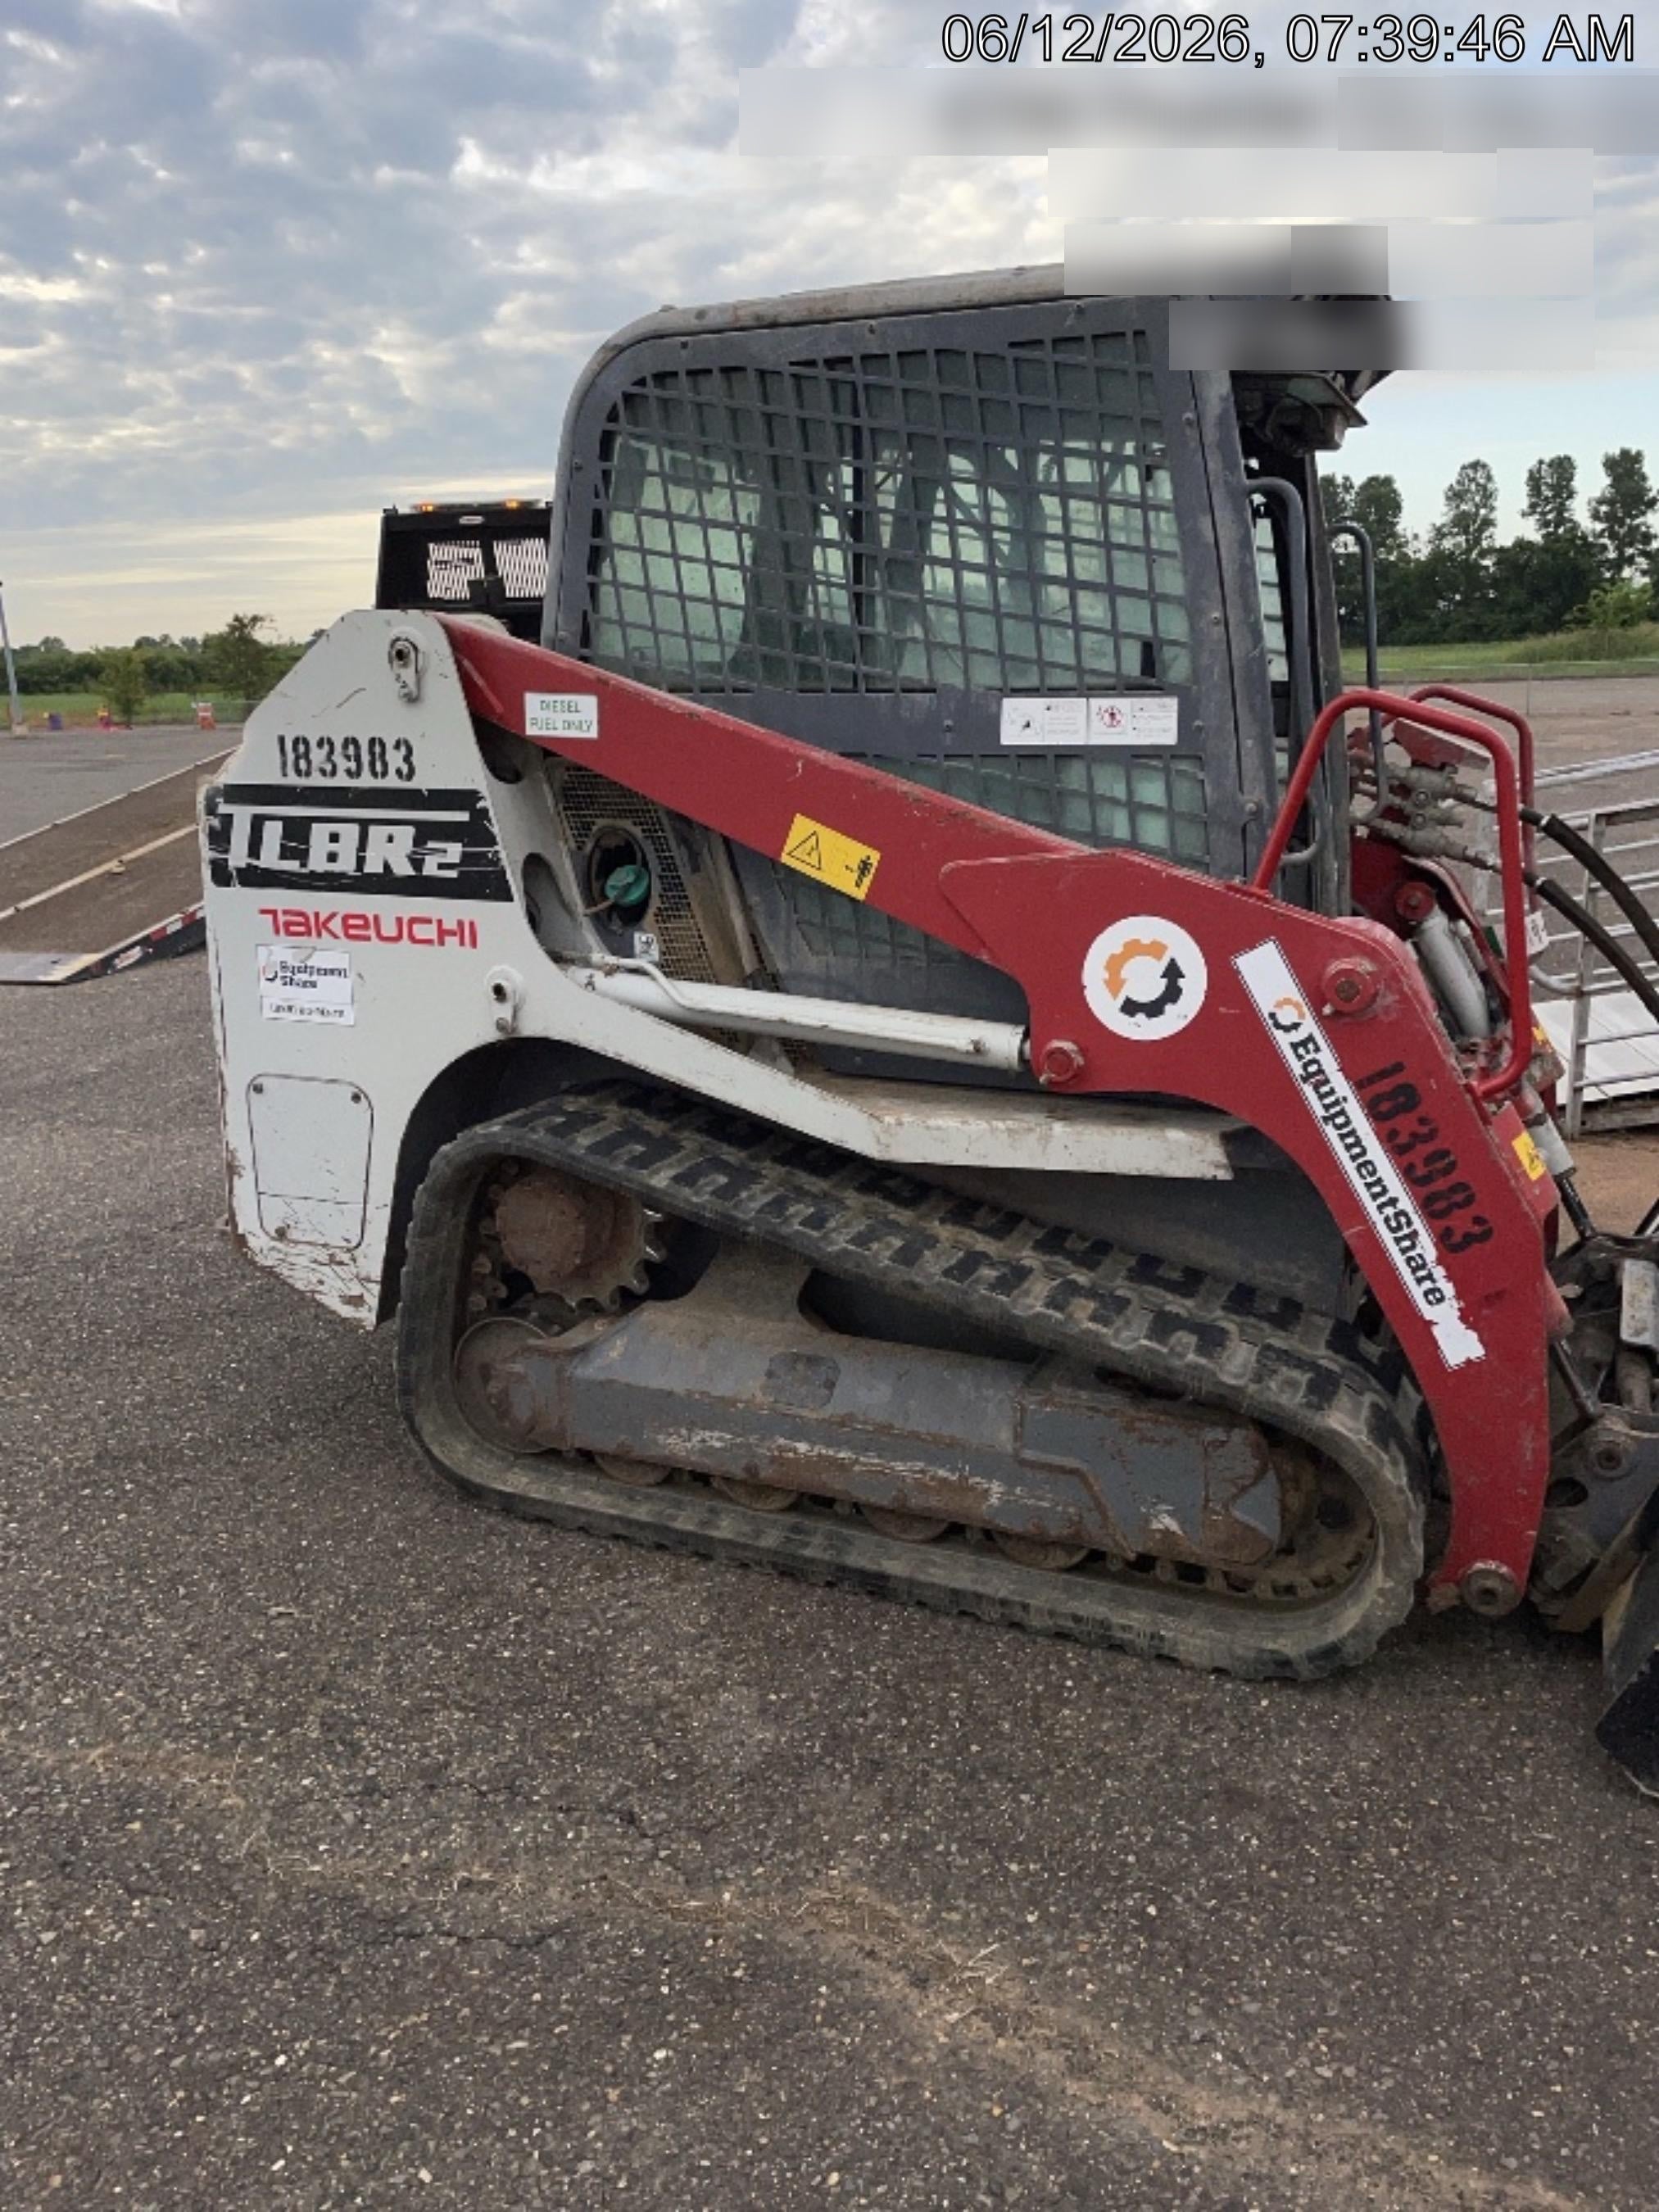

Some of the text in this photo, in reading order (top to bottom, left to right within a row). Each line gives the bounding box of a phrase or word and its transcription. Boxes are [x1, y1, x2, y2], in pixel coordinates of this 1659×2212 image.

[539, 699, 581, 714] DIESEL
[277, 734, 415, 782] 183983
[259, 909, 478, 949] TAKEUCHI
[1289, 1029, 1447, 1307] EquipmentShare
[1353, 1061, 1494, 1255] 183983
